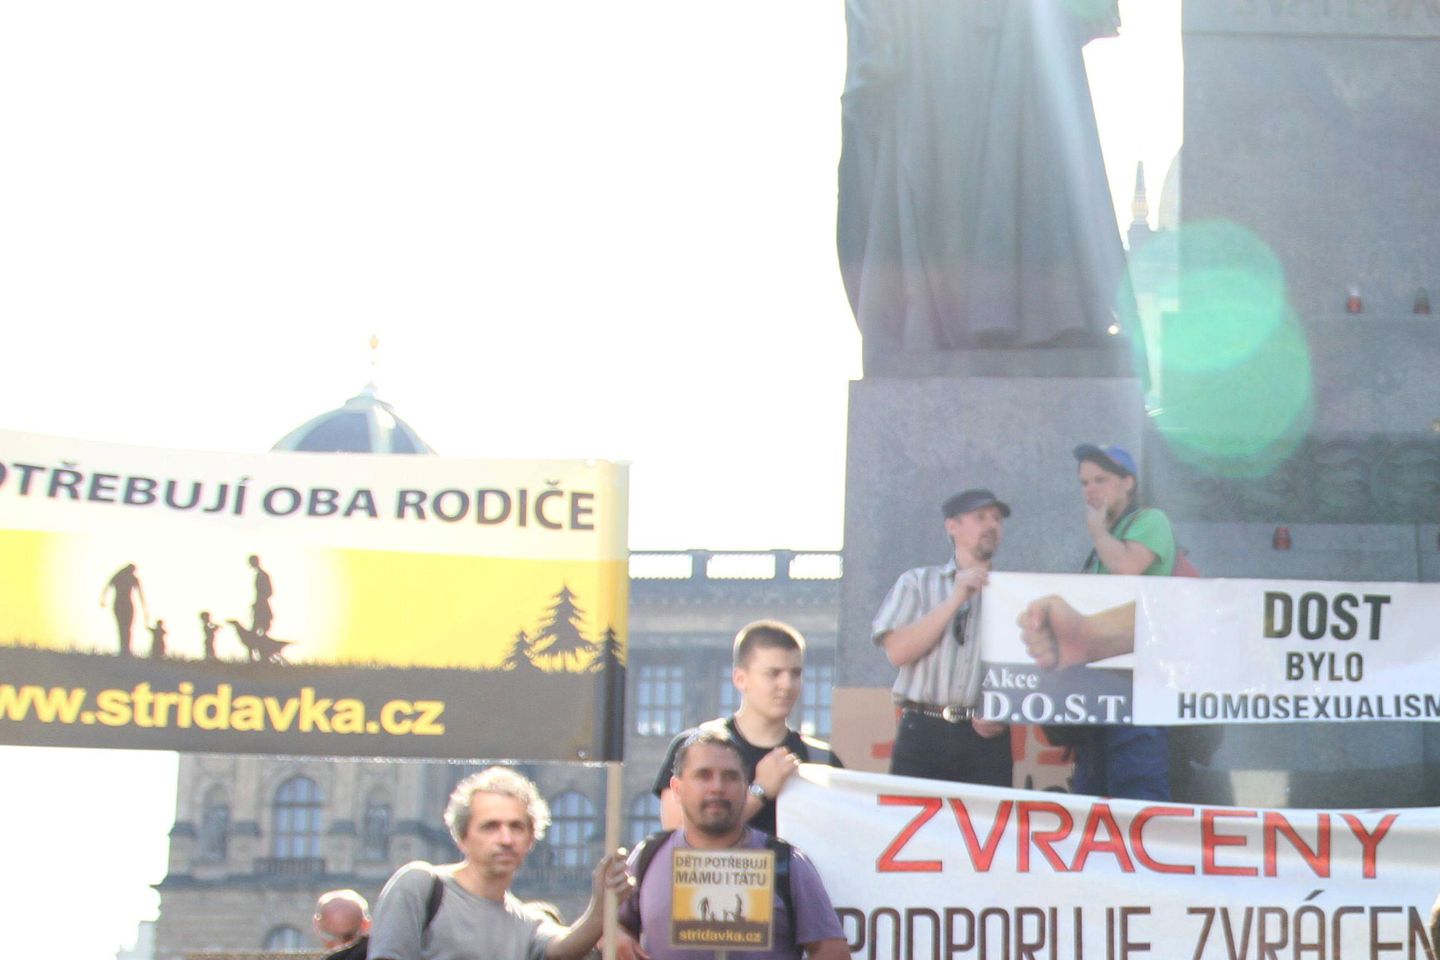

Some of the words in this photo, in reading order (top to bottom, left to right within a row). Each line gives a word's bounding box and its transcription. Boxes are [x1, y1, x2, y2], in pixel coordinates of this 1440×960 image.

[262, 484, 379, 518] OBA
[395, 480, 597, 531] RODIČE
[1263, 591, 1391, 641] DOST
[982, 668, 1038, 688] Akce
[1285, 651, 1364, 682] BYLO
[982, 691, 1131, 723] D.O.S.T.
[675, 855, 701, 868] DĚTI
[704, 855, 767, 869] POTŘEBUJÍ
[679, 929, 761, 943] stridavka.cz
